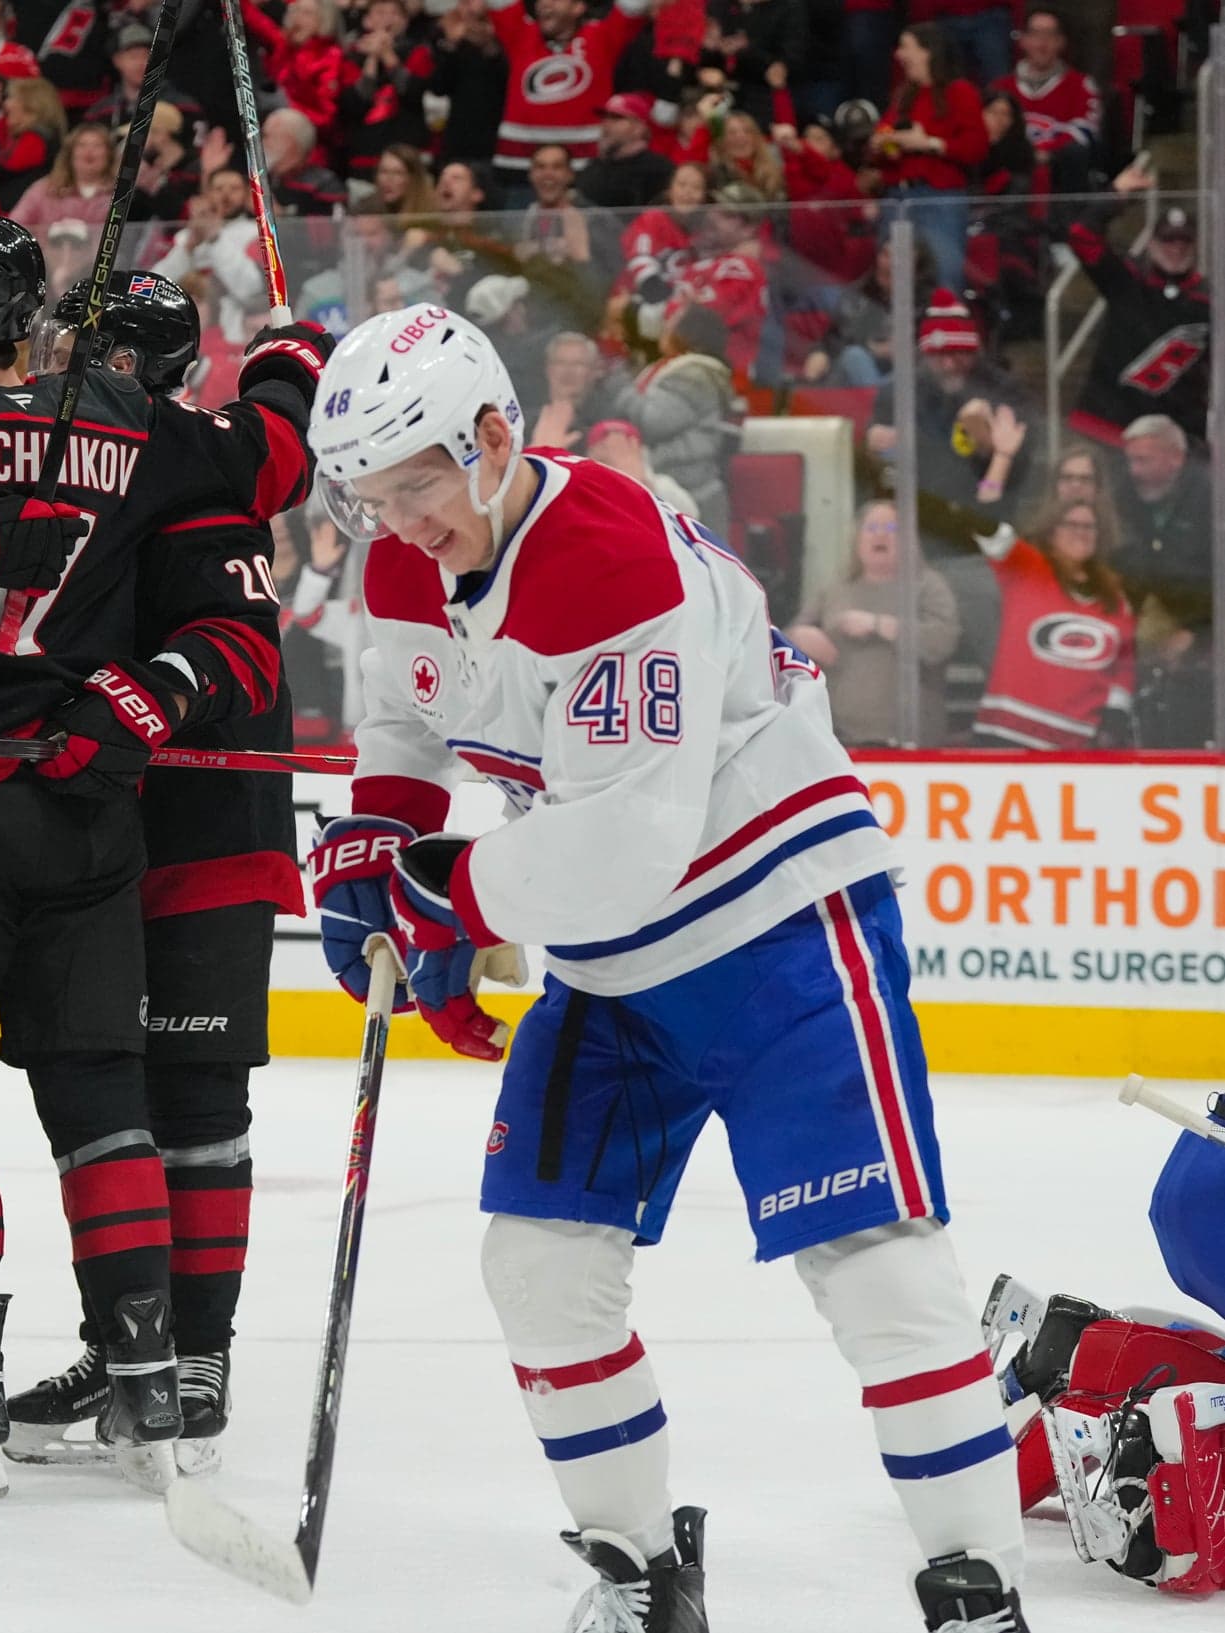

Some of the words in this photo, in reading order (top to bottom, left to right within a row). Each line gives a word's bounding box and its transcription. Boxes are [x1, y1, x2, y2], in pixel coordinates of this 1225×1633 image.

[94, 208, 123, 284] GHOST
[390, 314, 436, 354] CIBC
[324, 388, 352, 418] 48
[567, 650, 683, 744] 48
[868, 781, 1097, 842] ORAL
[926, 864, 1225, 929] ORTHO
[960, 949, 1058, 980] ORAL
